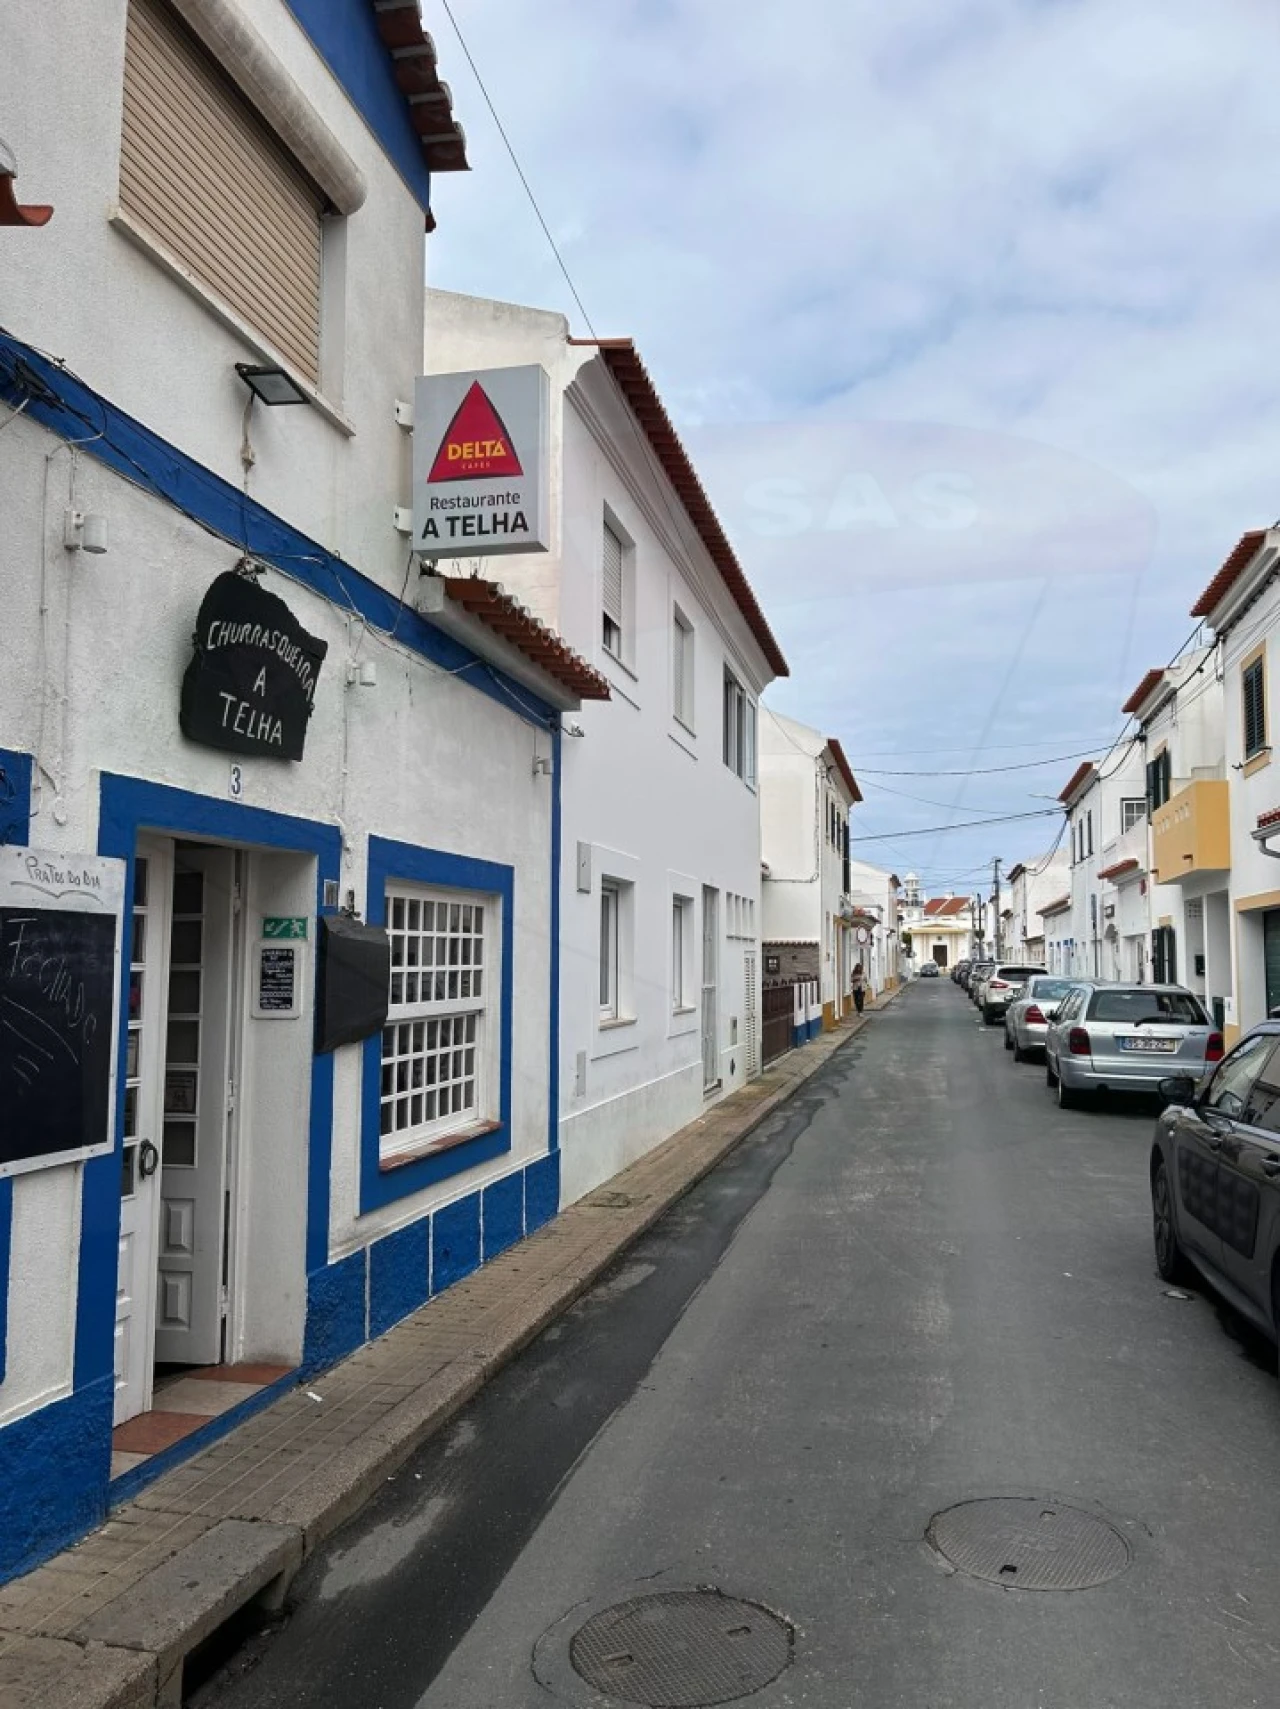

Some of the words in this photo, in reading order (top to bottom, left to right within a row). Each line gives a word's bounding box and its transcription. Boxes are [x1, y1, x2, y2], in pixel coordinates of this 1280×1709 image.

[447, 440, 507, 460] DELTA
[430, 491, 521, 510] Restaurante
[421, 517, 441, 540] A
[445, 510, 529, 537] TELHA
[206, 620, 314, 702] CHURRASQUEIRA
[252, 665, 267, 697] A
[218, 691, 283, 747] TELHA
[232, 766, 242, 795] 3
